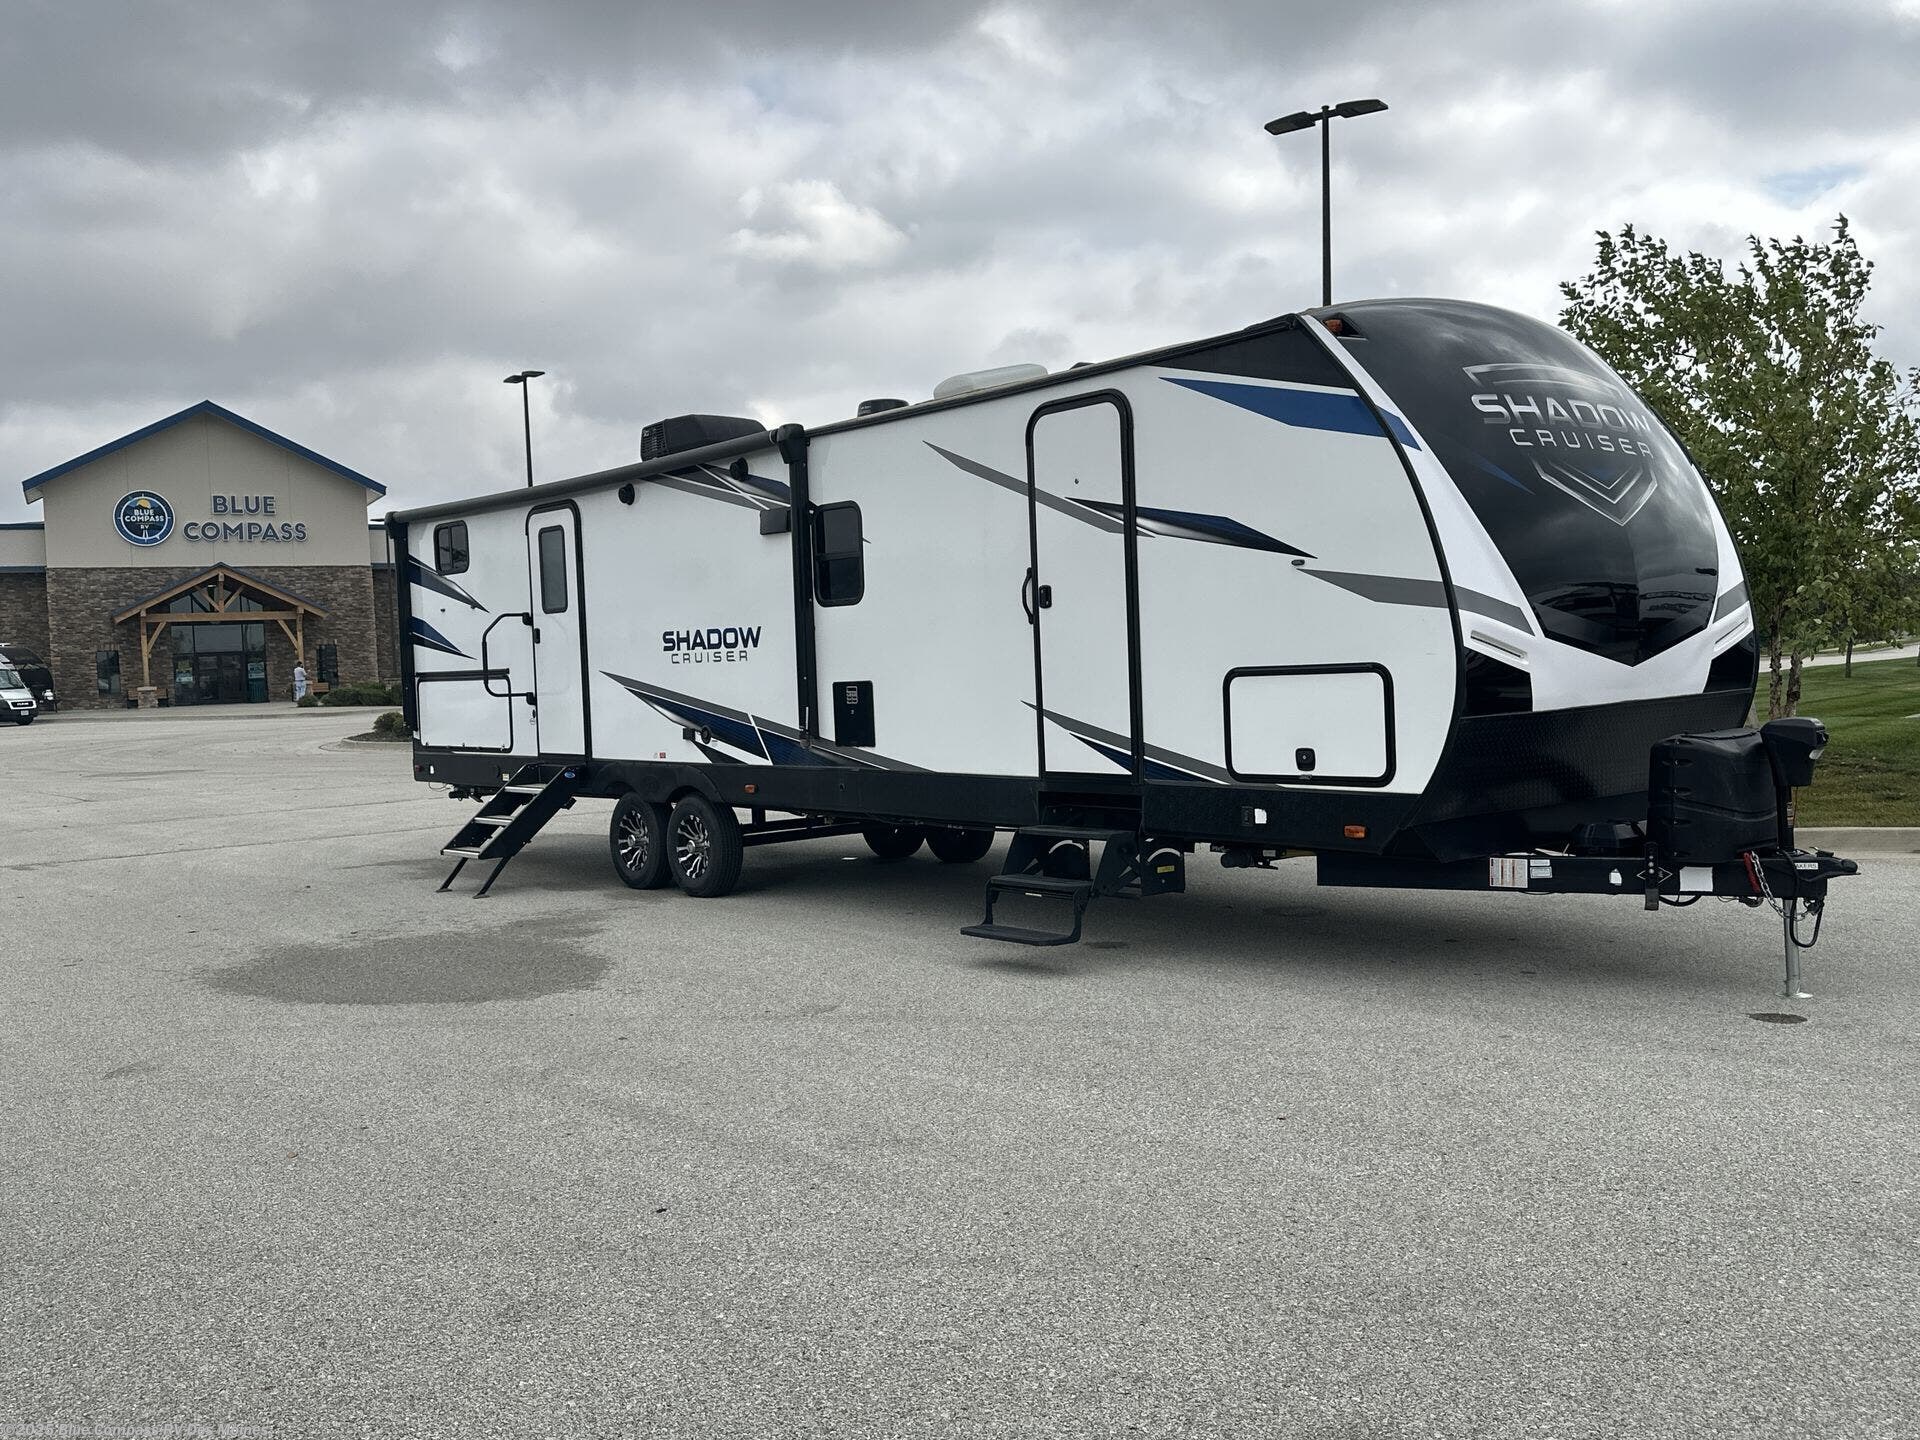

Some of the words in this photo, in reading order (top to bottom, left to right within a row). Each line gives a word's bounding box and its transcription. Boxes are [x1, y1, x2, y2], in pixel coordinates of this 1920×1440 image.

[1471, 393, 1651, 432] SHADOW
[1509, 428, 1654, 458] CRUISER
[134, 508, 154, 516] BLUE
[212, 494, 277, 514] BLUE
[183, 521, 308, 541] COMPASS
[662, 626, 762, 652] SHADOW
[671, 650, 749, 664] CRUISER
